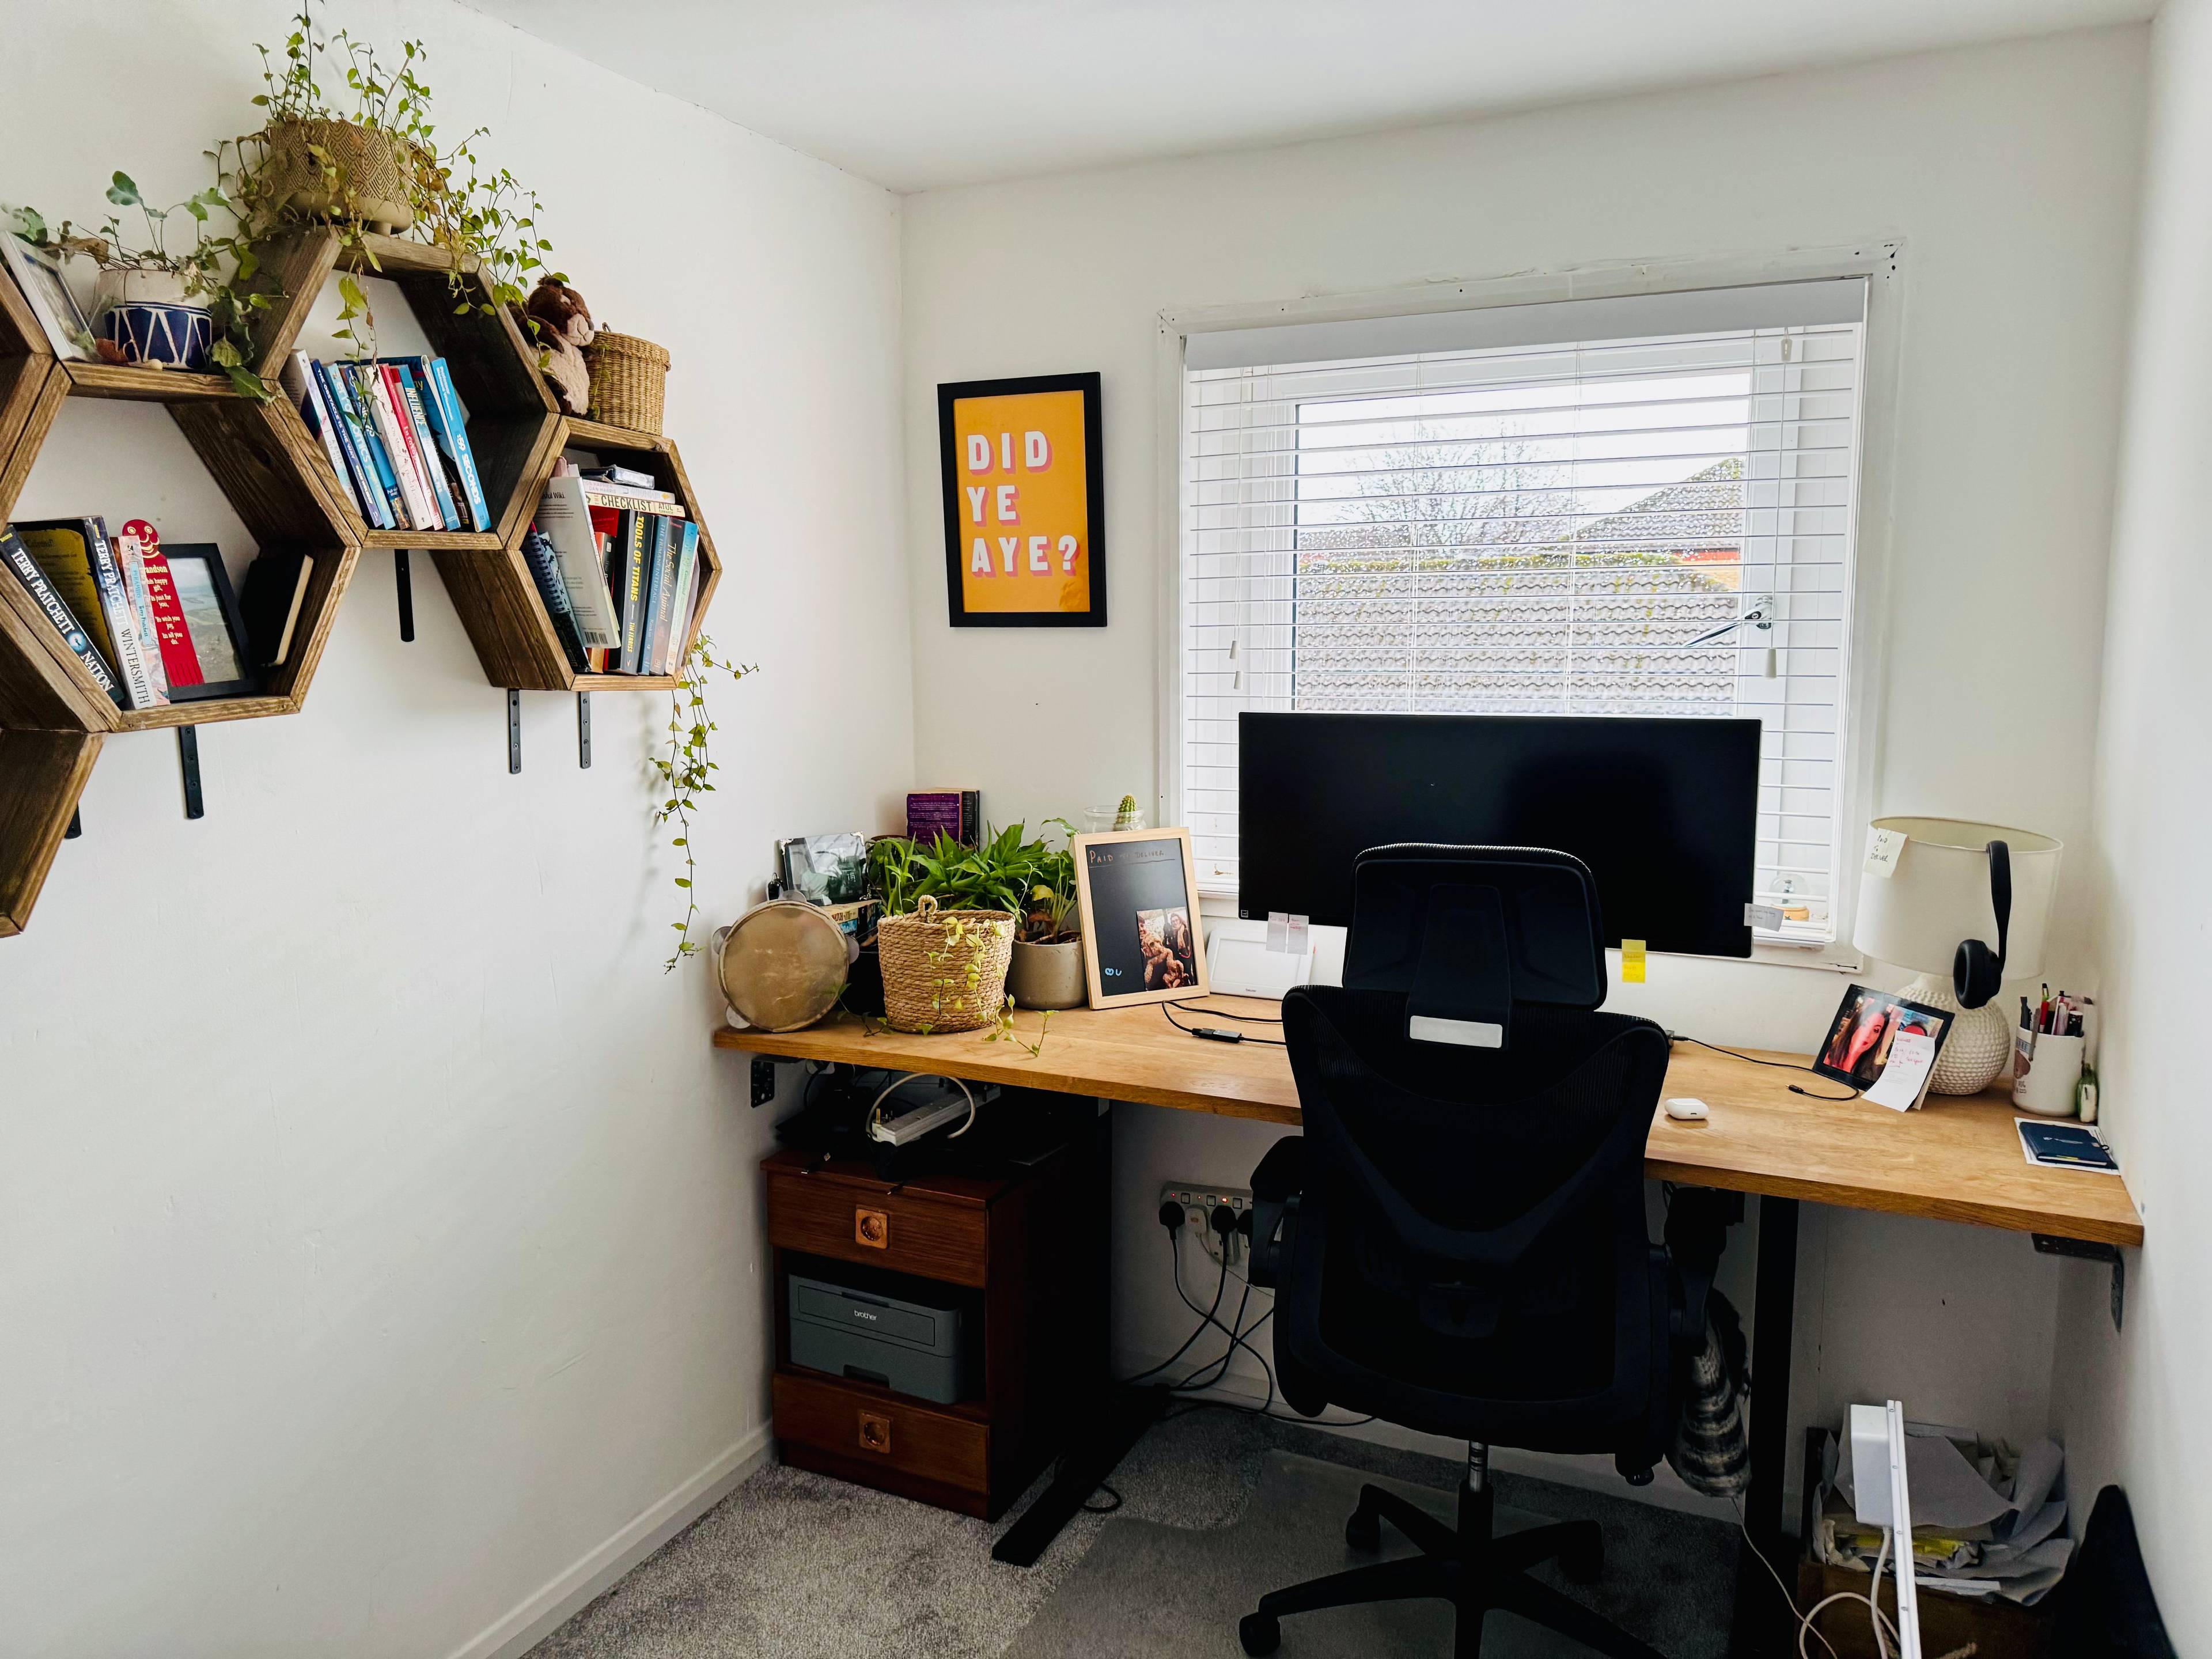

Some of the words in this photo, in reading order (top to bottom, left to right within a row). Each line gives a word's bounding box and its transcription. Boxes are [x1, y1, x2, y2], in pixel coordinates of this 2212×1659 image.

[317, 368, 325, 383] THE
[323, 384, 339, 419] OBSTACLE
[347, 443, 355, 459] WAY
[337, 382, 370, 463] erroomics
[404, 387, 427, 425] INFLUENCE
[967, 431, 1052, 475] DID
[462, 453, 481, 505] SECONDS
[601, 495, 652, 512] CHECKLIST
[966, 485, 1021, 527] YE
[634, 516, 644, 548] TOOLS
[666, 543, 676, 559] The
[94, 540, 113, 571] TERRY
[634, 550, 642, 564] OF
[663, 559, 675, 586] Social
[971, 535, 1080, 577] AYE?
[103, 573, 128, 625] PRATCHETT
[630, 566, 641, 601] TITANS
[10, 548, 40, 581] TERRY
[31, 578, 75, 634] PRATCHETT
[80, 650, 115, 692] NATION
[659, 586, 671, 622] Animal
[121, 628, 150, 703] WINTERSMITH
[854, 1309, 877, 1321] brother
